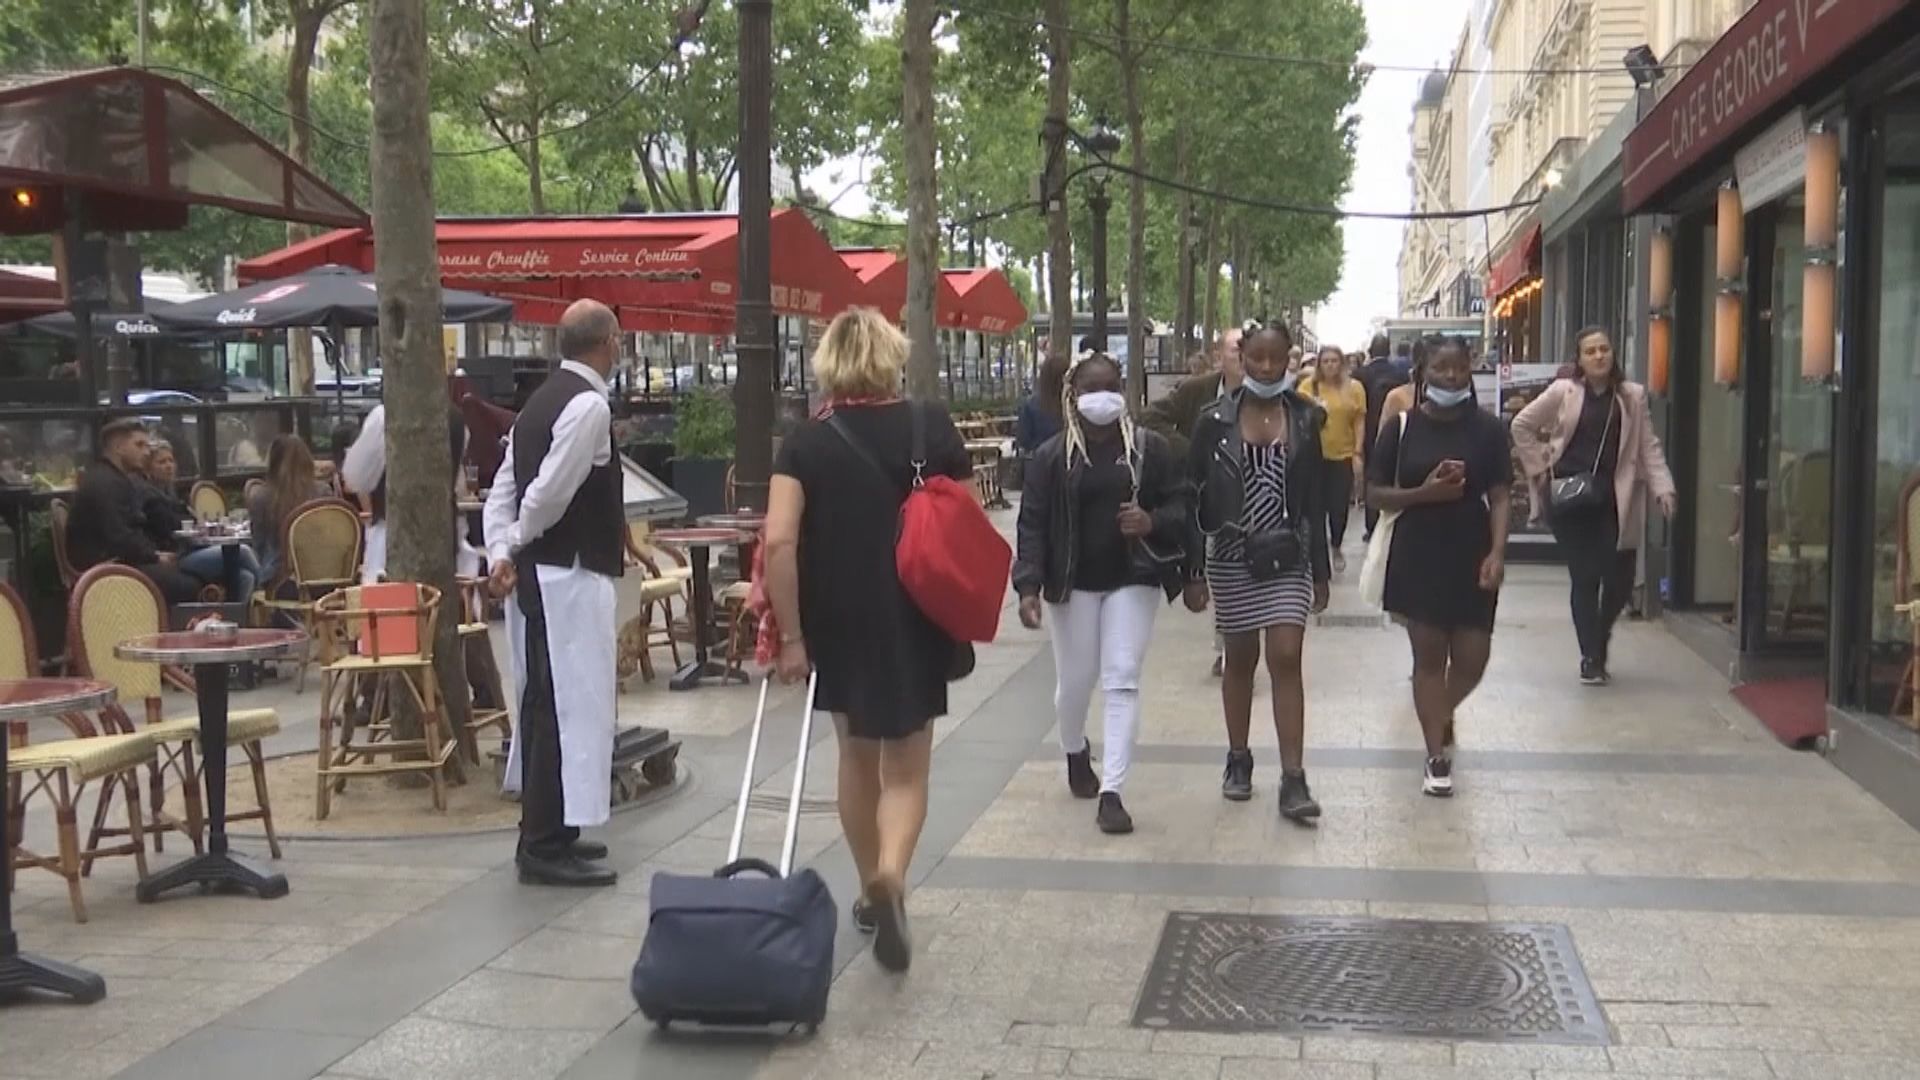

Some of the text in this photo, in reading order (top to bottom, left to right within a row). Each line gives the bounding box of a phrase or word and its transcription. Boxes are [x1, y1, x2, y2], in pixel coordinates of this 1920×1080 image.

[1671, 0, 1809, 160] CAFE GEORGE V
[439, 254, 481, 266] rrasse
[580, 247, 630, 266] Service
[635, 247, 689, 267] Continu
[216, 308, 257, 325] Quick
[115, 319, 160, 335] Quick
